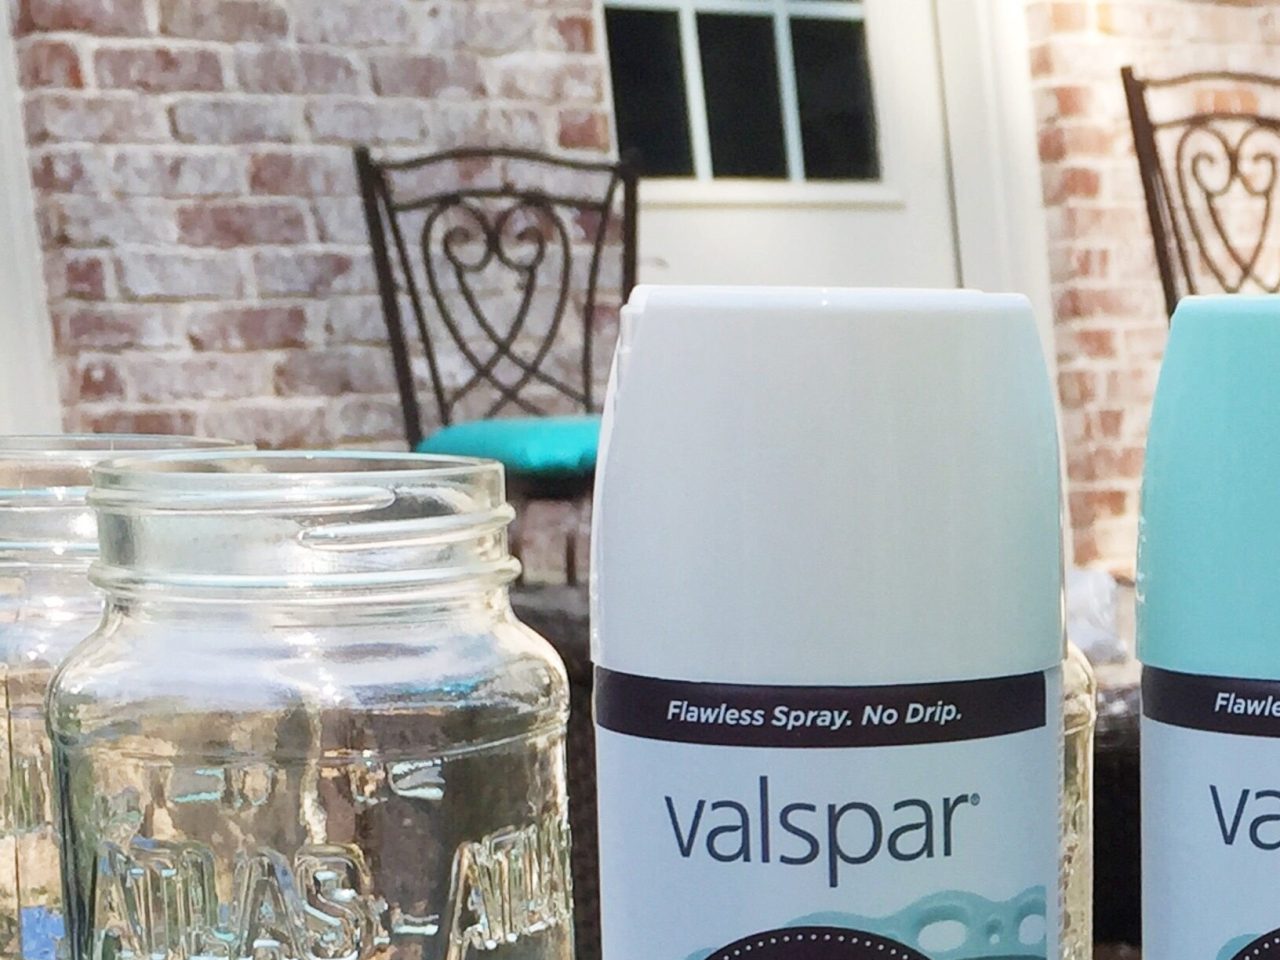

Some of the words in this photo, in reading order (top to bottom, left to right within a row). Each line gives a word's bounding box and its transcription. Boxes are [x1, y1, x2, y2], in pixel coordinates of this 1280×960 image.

[667, 701, 765, 726] Flawless
[772, 706, 851, 729] Spray.
[861, 704, 898, 726] No
[905, 700, 963, 723] Drip.
